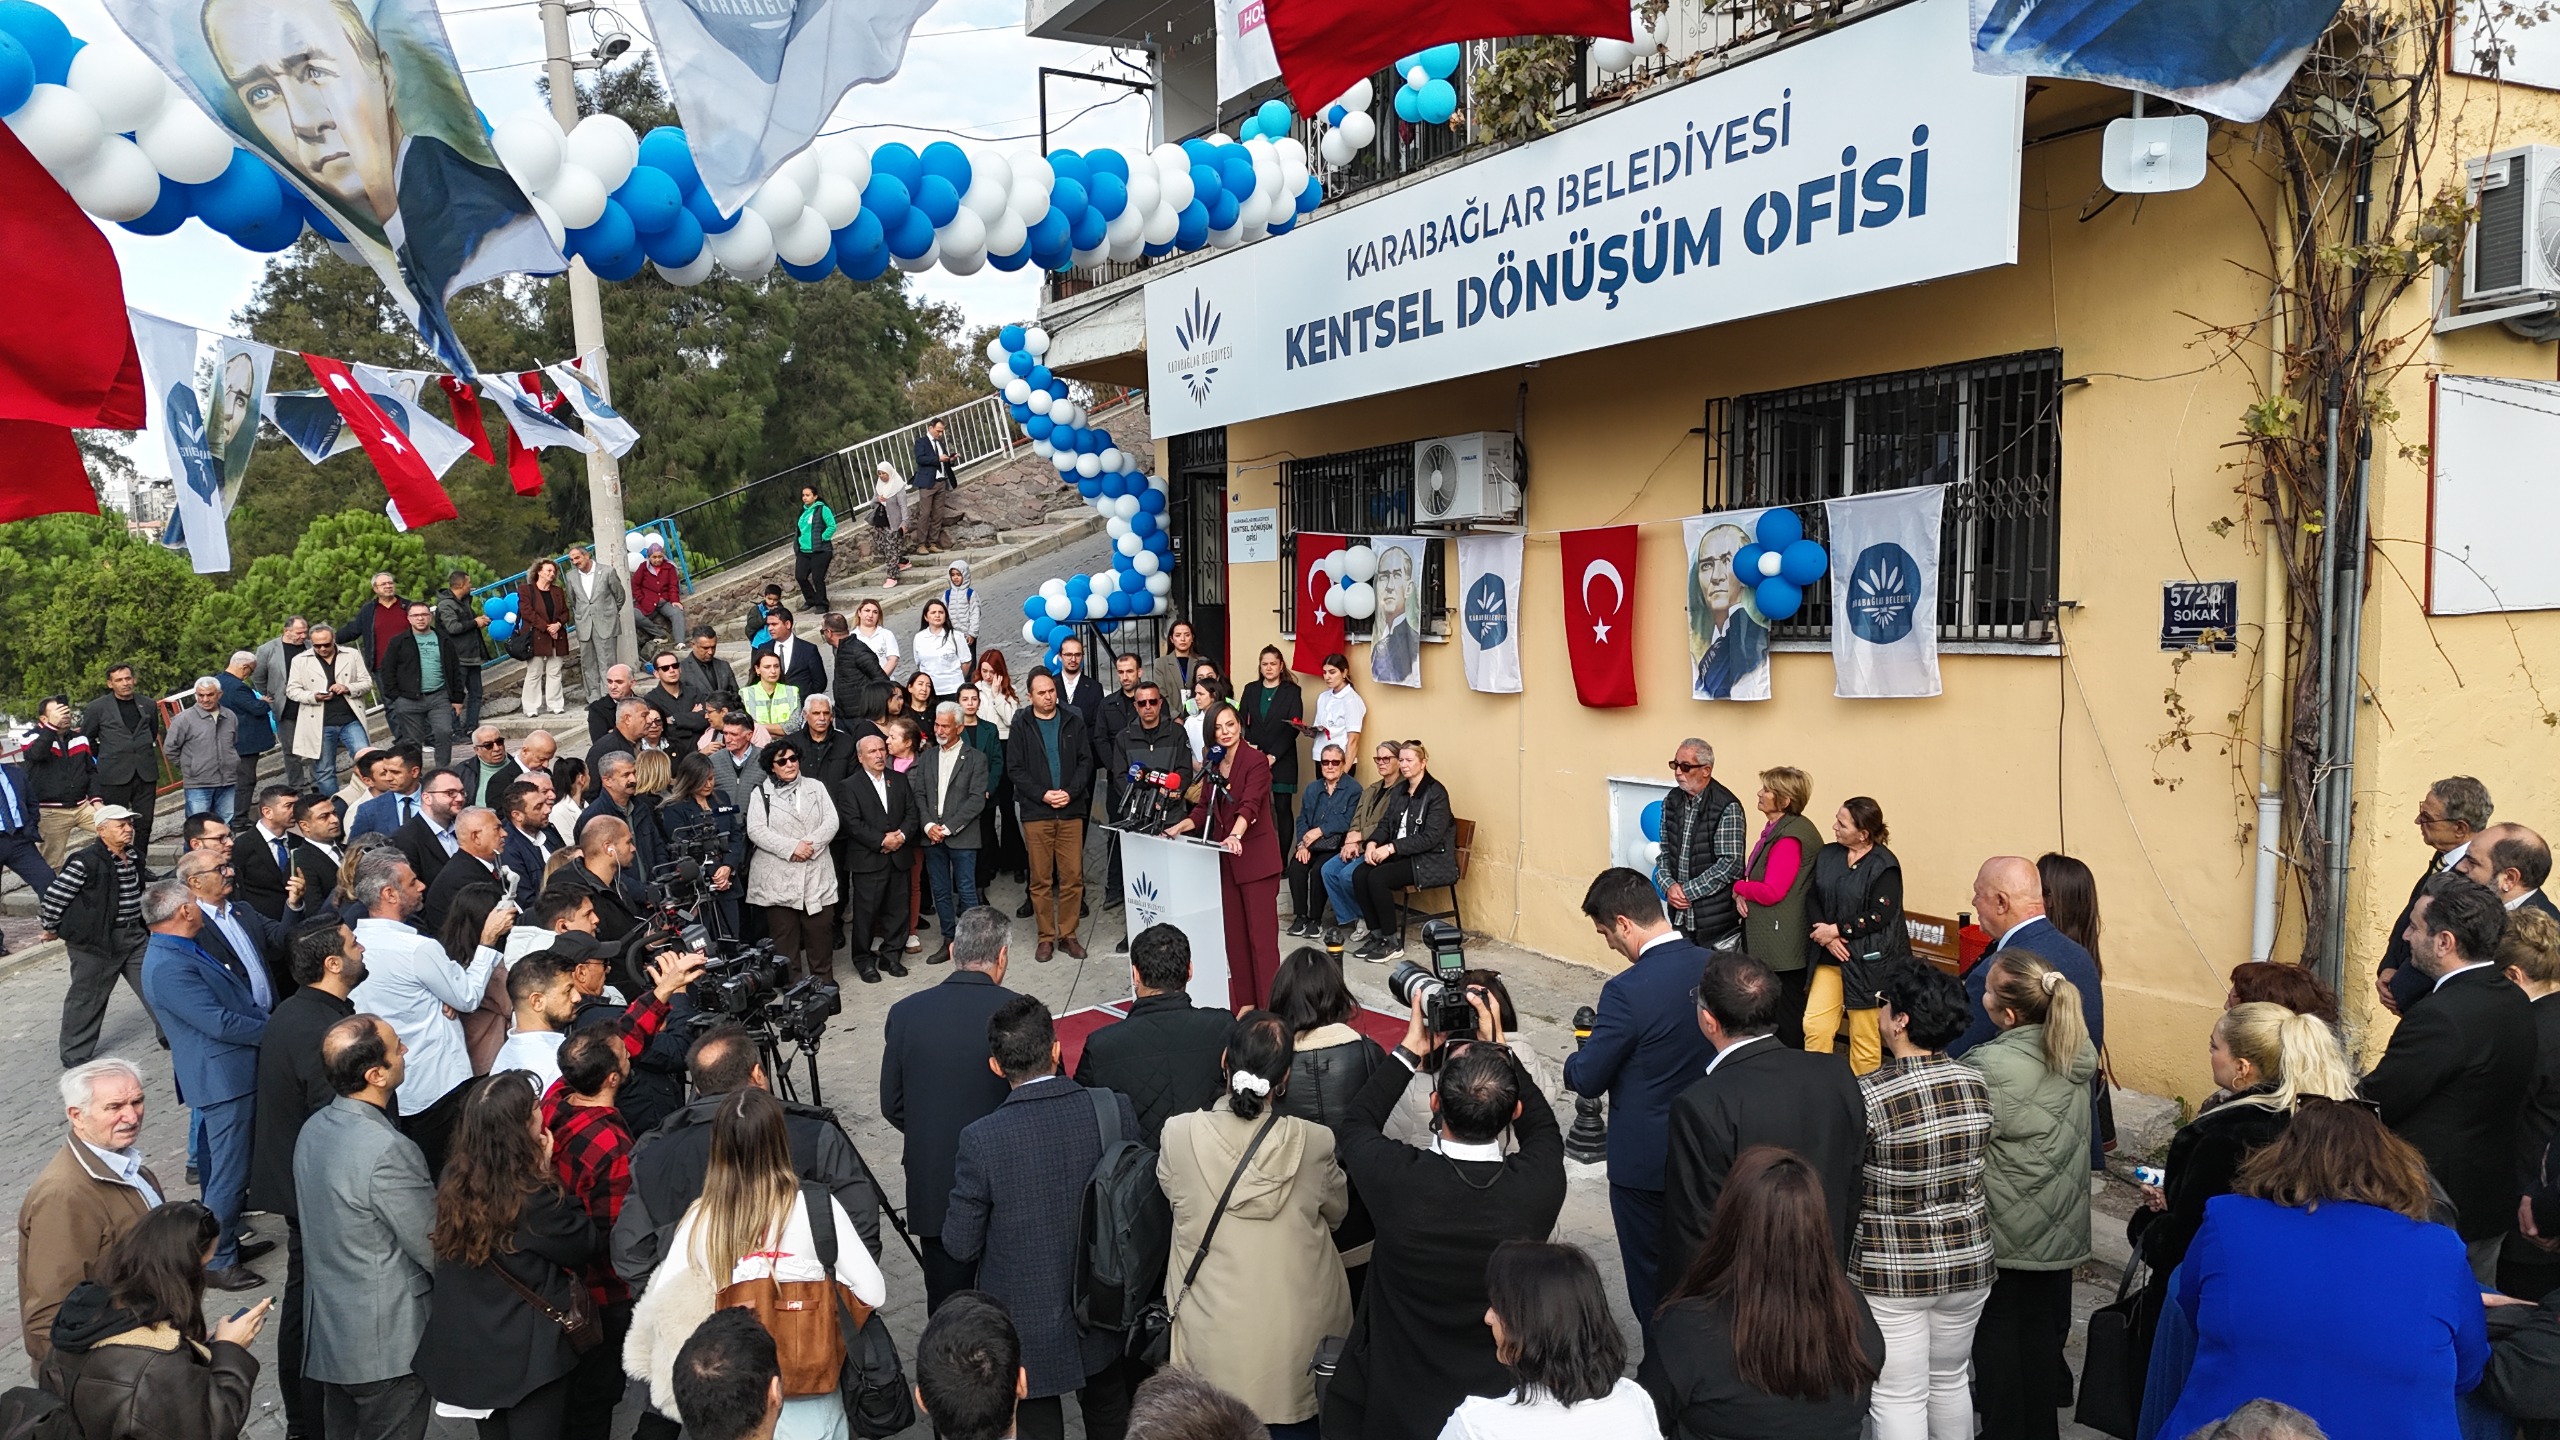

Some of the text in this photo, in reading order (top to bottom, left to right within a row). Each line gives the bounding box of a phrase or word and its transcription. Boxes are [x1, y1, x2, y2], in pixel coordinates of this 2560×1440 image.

[1347, 88, 1791, 281] KARABAĞLAR BELEDİYESİ
[1286, 124, 1929, 370] KENTSEL DÖNÜŞÜM OFİSİ
[1202, 342, 1233, 365] BELEDİYESİ
[2174, 609, 2220, 621] SOKAK
